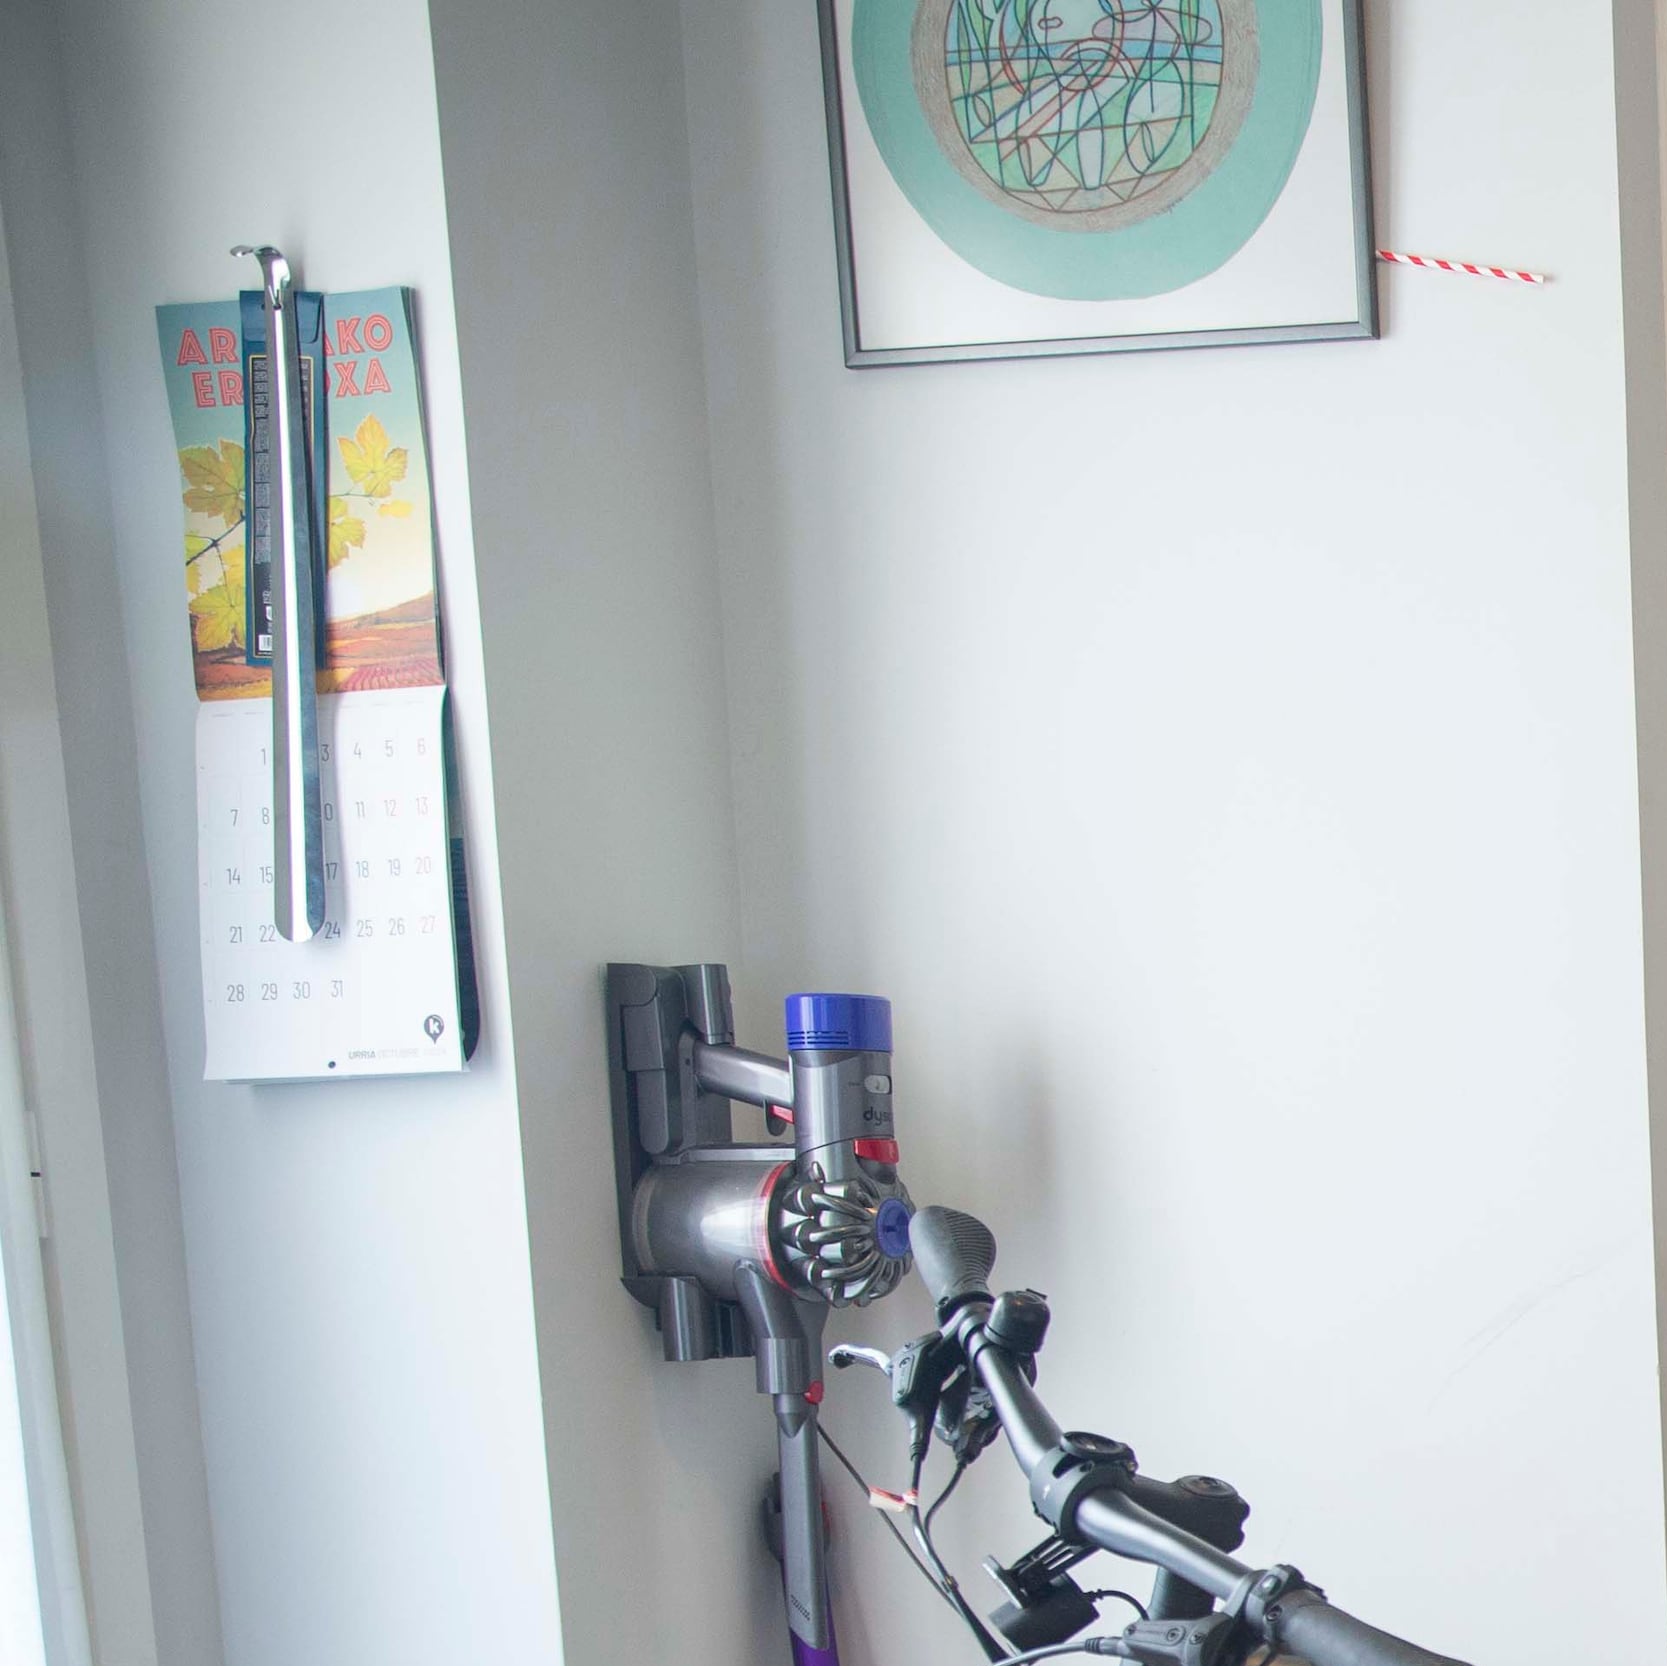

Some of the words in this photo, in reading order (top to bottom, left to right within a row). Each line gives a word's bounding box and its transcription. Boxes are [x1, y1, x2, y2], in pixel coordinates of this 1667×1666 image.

[177, 313, 393, 366] ARKO
[191, 357, 392, 408] ERXA
[321, 744, 330, 762] 3
[353, 742, 362, 760] 4
[384, 739, 394, 757] 5
[230, 808, 239, 826] 7
[261, 807, 270, 825] 8
[356, 801, 365, 819] 11
[385, 799, 397, 817] 12
[415, 796, 429, 815] 13
[226, 867, 241, 885] 14
[259, 865, 274, 884] 15
[325, 862, 338, 880] 17
[356, 860, 369, 878] 18
[388, 858, 401, 876] 19
[415, 856, 431, 874] 20
[229, 926, 243, 943] 21
[259, 925, 275, 942] 22
[324, 921, 341, 939] 24
[356, 919, 373, 937] 25
[388, 918, 406, 936] 26
[420, 916, 436, 934] 27
[227, 984, 245, 1002] 28
[261, 983, 278, 1000] 29
[293, 981, 311, 999] 30
[330, 980, 343, 998] 31
[863, 1106, 889, 1126] dys
